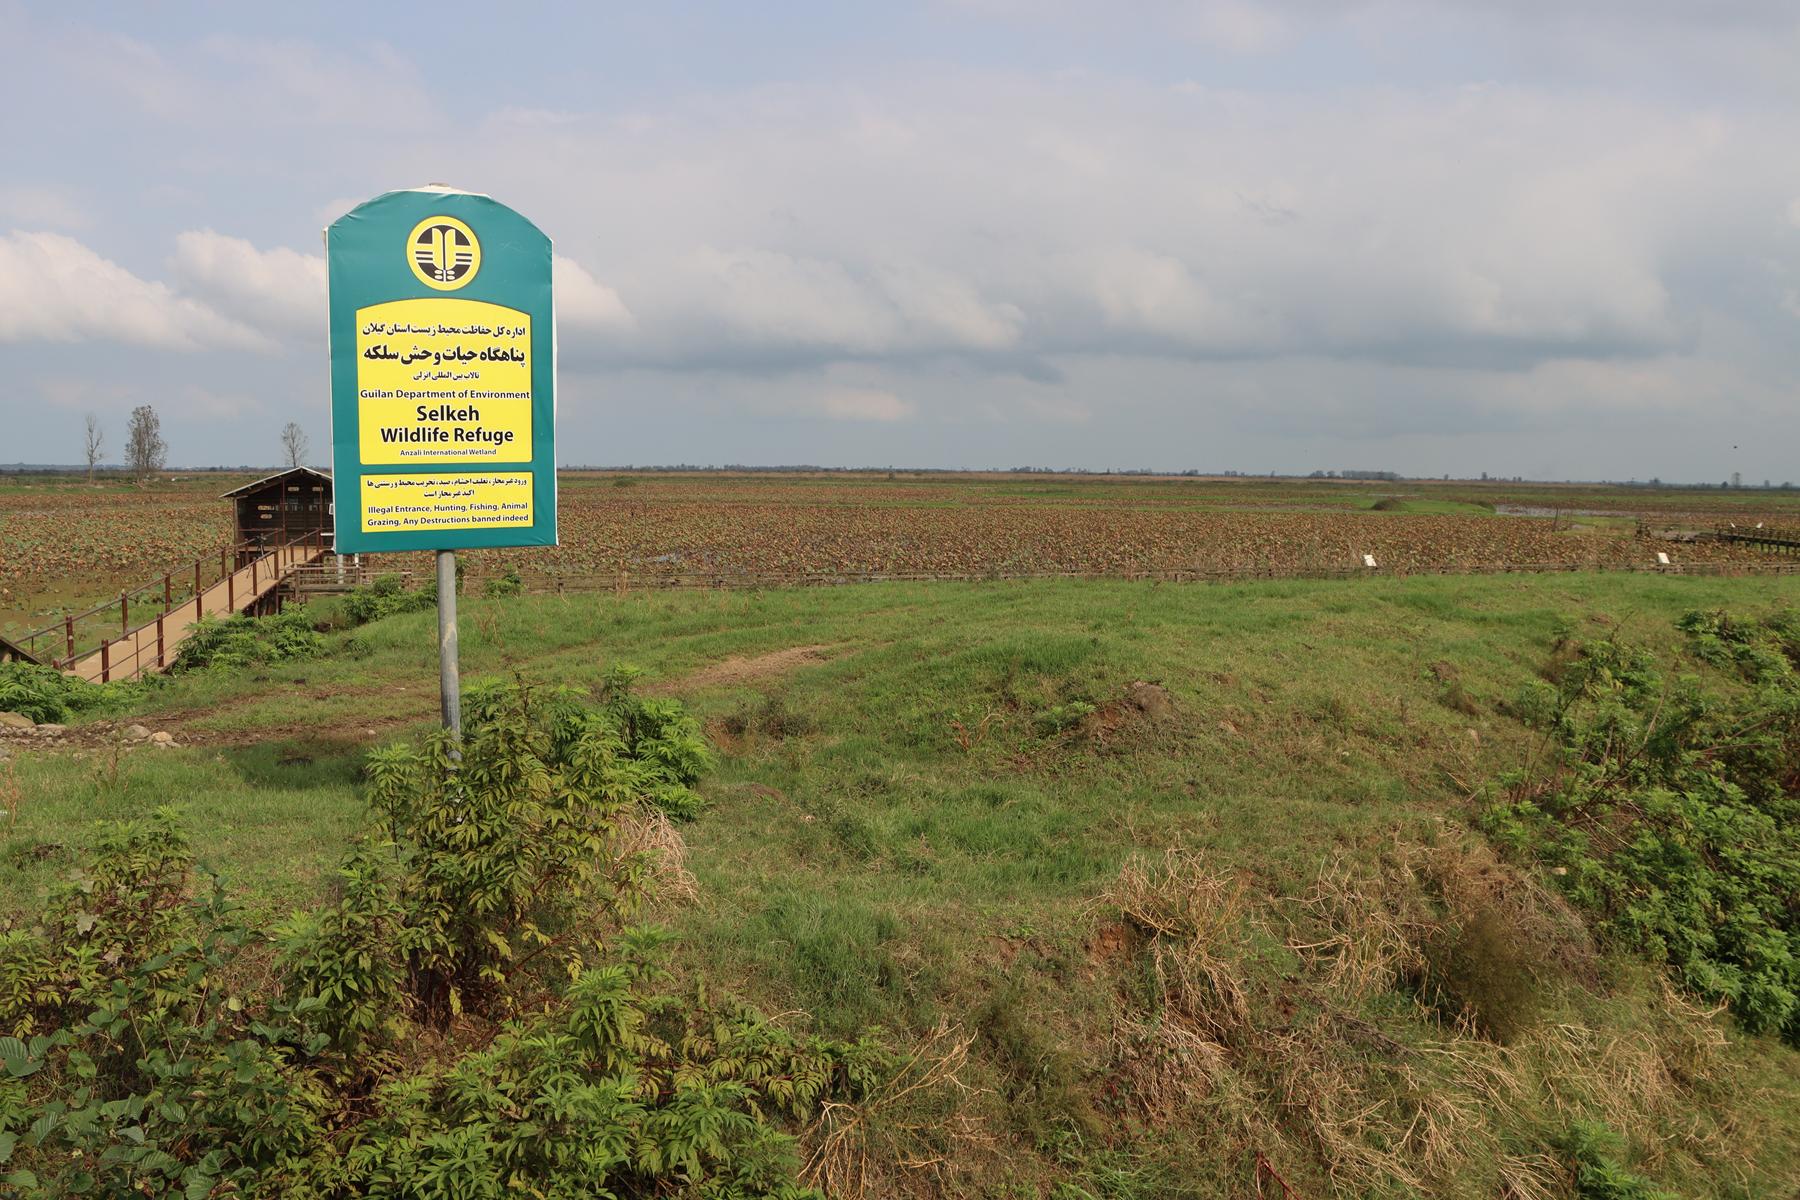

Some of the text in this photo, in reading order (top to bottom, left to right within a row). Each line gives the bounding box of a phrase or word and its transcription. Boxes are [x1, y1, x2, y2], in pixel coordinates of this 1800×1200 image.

[387, 323, 411, 336] استان
[437, 324, 461, 336] محیط
[462, 325, 492, 335] حفاظت
[493, 326, 505, 338] کل
[506, 327, 526, 338] اداره
[363, 344, 399, 360] سلکه
[442, 345, 478, 365] حیات
[479, 346, 526, 367] پناهگاه
[360, 389, 530, 400] Guilan Department of Environment
[416, 405, 480, 421] Selkeh
[380, 427, 514, 446] Wildlife Refuge
[368, 502, 528, 515] Illegal Entrance, Hunting, Fishing, Animal
[367, 514, 529, 527] Grazing, Any Destructions banned indeed
